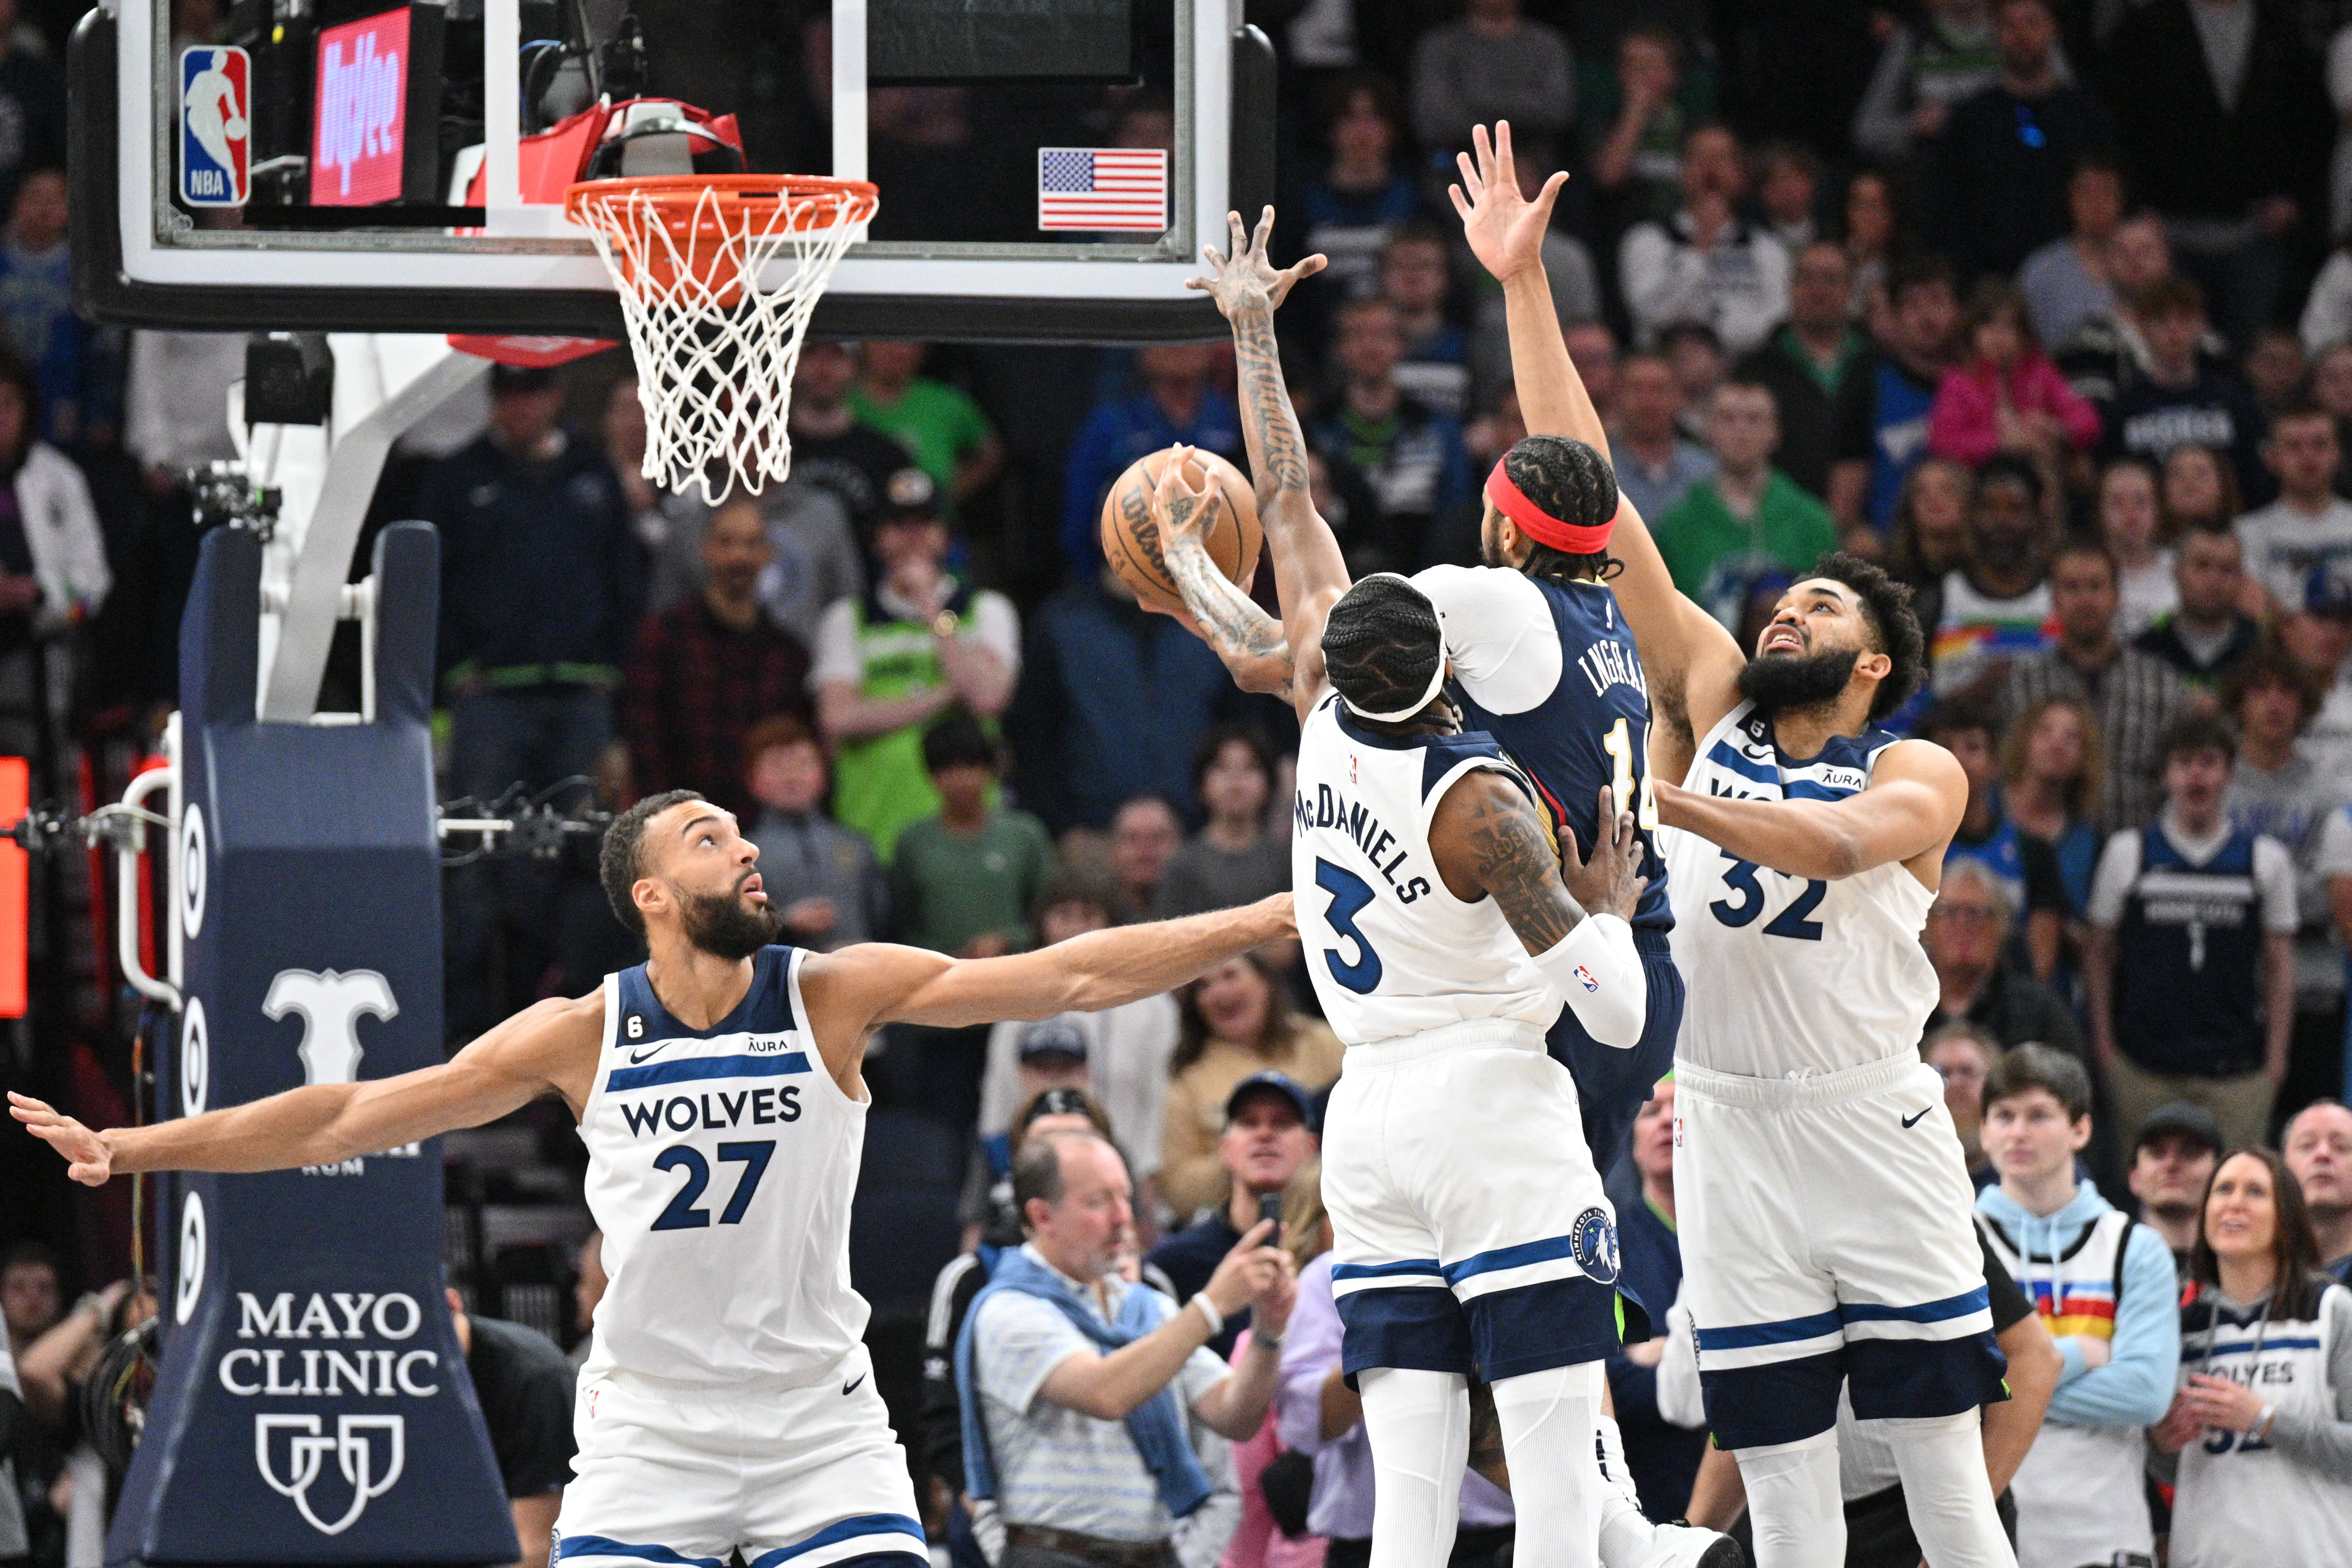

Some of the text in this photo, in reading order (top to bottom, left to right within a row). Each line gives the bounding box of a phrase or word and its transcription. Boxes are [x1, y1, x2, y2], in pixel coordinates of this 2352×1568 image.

[191, 170, 224, 196] NBA
[1750, 719, 1765, 738] 6
[1710, 849, 1826, 941] 32
[1315, 855, 1382, 995] 3
[627, 1015, 643, 1038] 6
[621, 1086, 801, 1138] WOLVES
[650, 1140, 777, 1231] 27
[1573, 1211, 1592, 1261] MINNESOTA
[236, 1292, 421, 1340] MAYO
[219, 1348, 439, 1397] CLINIC
